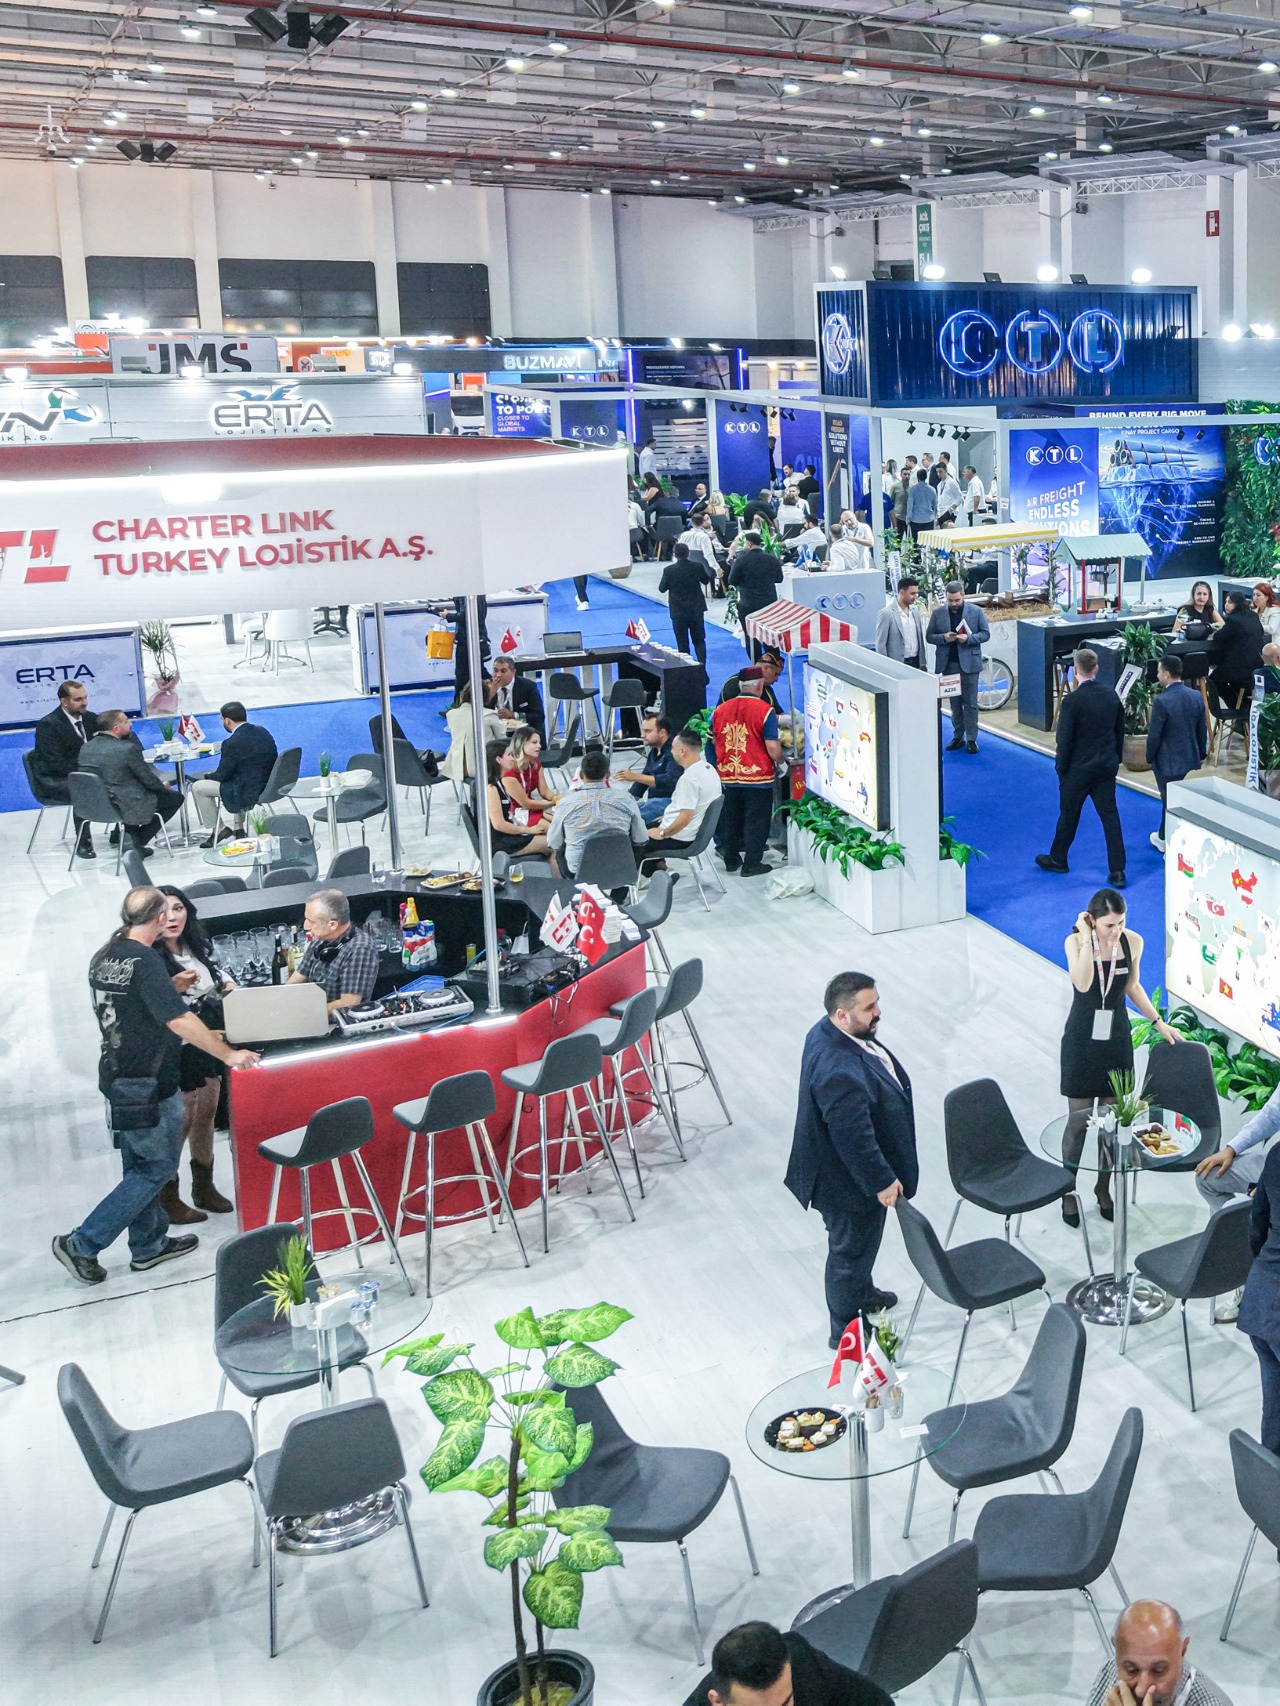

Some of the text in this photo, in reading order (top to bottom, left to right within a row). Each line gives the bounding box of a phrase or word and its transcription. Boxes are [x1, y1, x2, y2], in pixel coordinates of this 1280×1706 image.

[943, 312, 1118, 372] KTL
[214, 403, 332, 427] ERTA
[497, 406, 513, 414] TO
[571, 426, 608, 437] KTL
[725, 422, 760, 434] KTL
[1027, 446, 1082, 464] KTL
[1040, 481, 1086, 505] FREIGHT
[1028, 499, 1080, 519] ENDLESS
[92, 509, 335, 543] CHARTER LINK
[93, 534, 434, 576] TURKEY LOJİSTİK A.Ş.
[16, 664, 96, 684] ERTA
